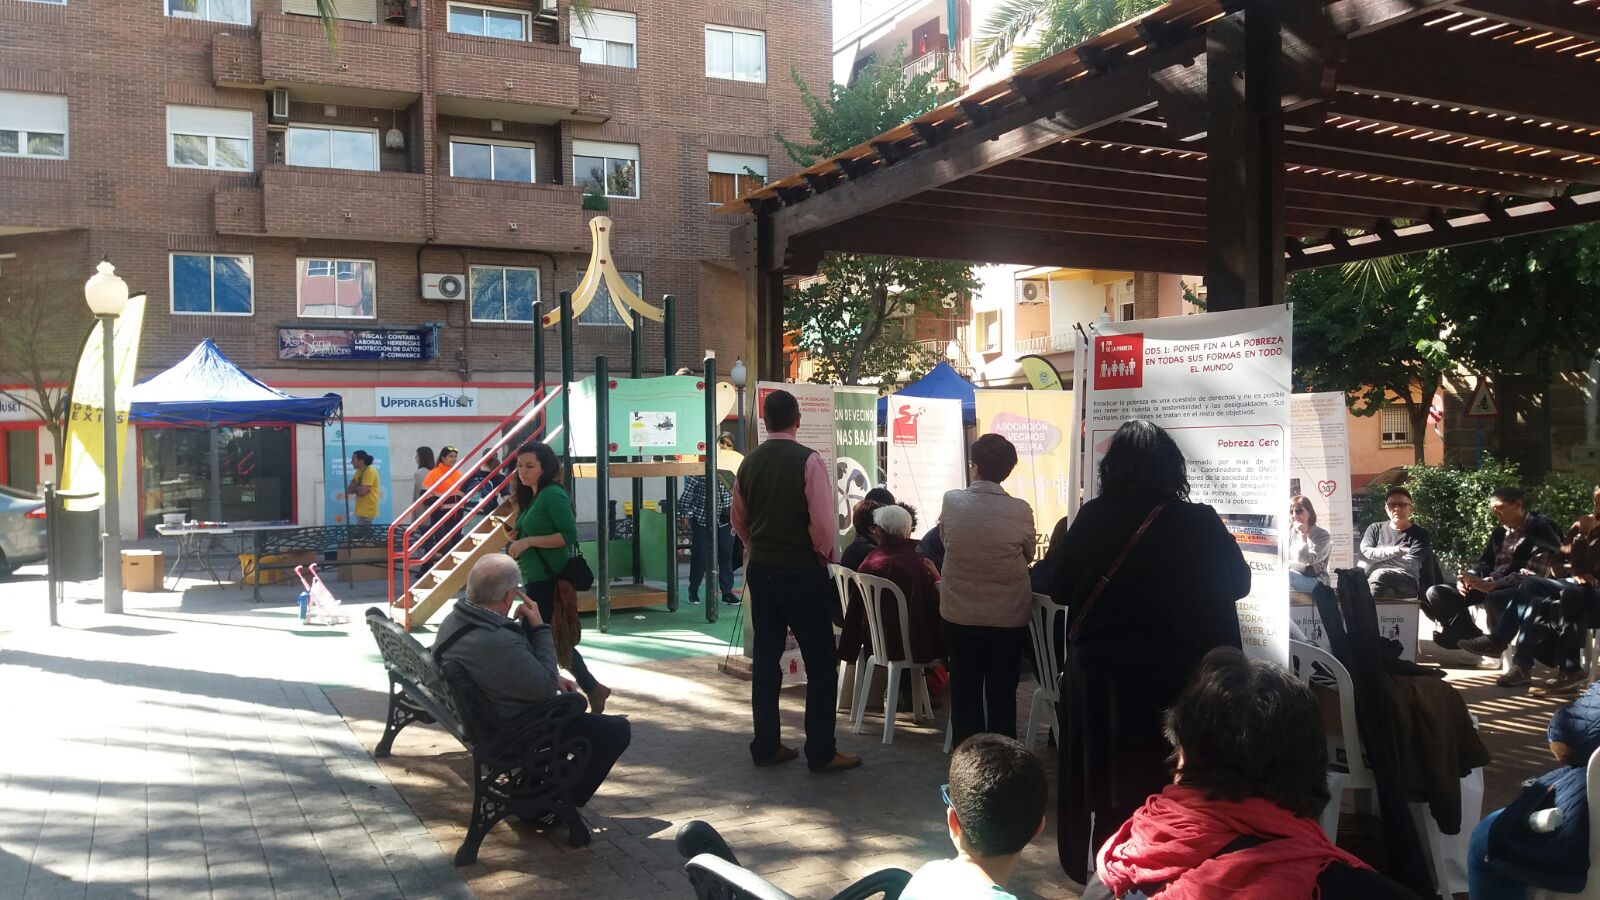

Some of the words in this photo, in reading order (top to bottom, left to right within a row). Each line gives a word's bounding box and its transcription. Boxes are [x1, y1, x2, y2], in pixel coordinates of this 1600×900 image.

[354, 344, 392, 352] PROTECCIÓN
[1101, 341, 1105, 353] 1
[1145, 347, 1161, 355] ODS
[1173, 343, 1200, 353] PONER
[1203, 341, 1218, 351] FIN
[1221, 341, 1226, 349] A
[1229, 340, 1240, 348] LA
[1243, 336, 1284, 347] POBREZA
[1145, 358, 1156, 366] EN
[1158, 356, 1184, 365] TODAS
[1187, 354, 1203, 362] SUS
[1206, 352, 1242, 361] FORMAS
[1245, 350, 1256, 358] EN
[1258, 347, 1283, 357] TODO
[1202, 362, 1234, 373] MUNDO
[1126, 399, 1149, 407] pobreza
[1208, 394, 1236, 402] derechos
[1263, 391, 1285, 399] posible
[71, 411, 125, 424] EXIS
[834, 405, 844, 421] ÓN
[845, 409, 851, 421] DE
[836, 430, 852, 445] NAS
[1217, 439, 1255, 448] Pobreza
[1258, 439, 1280, 447] Cero
[1212, 490, 1239, 498] Pobreza,
[1034, 533, 1050, 544] ZA
[1381, 616, 1404, 625] limpia
